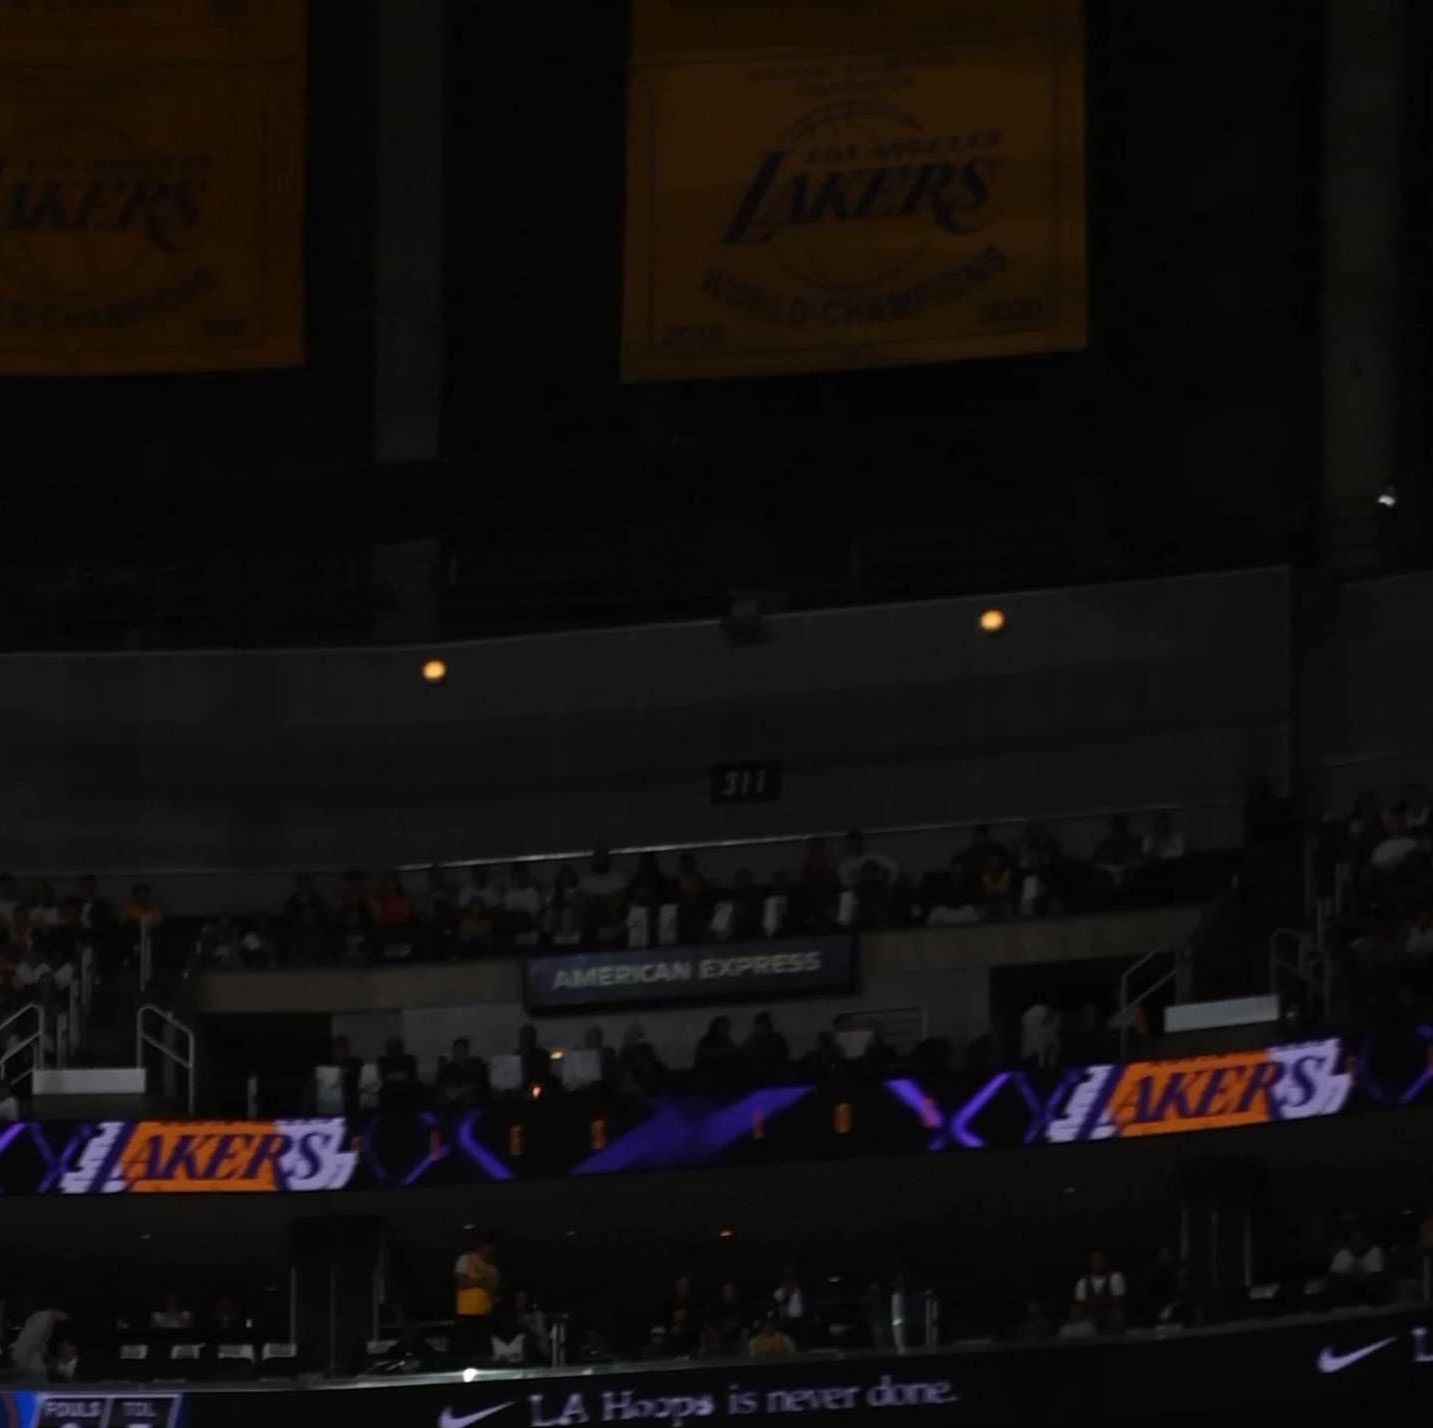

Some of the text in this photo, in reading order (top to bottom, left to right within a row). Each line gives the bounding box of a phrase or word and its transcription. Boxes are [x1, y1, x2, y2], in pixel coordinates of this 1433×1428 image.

[721, 769, 768, 796] 311
[551, 951, 822, 991] AMERICAN EXPRESS
[1073, 1053, 1330, 1141] LAKERS
[87, 1120, 335, 1194] LAKERS
[45, 1401, 102, 1418] FOULS
[529, 1392, 590, 1428] LA
[601, 1388, 715, 1428] Hoops
[728, 1384, 757, 1415] is
[767, 1385, 861, 1413] never
